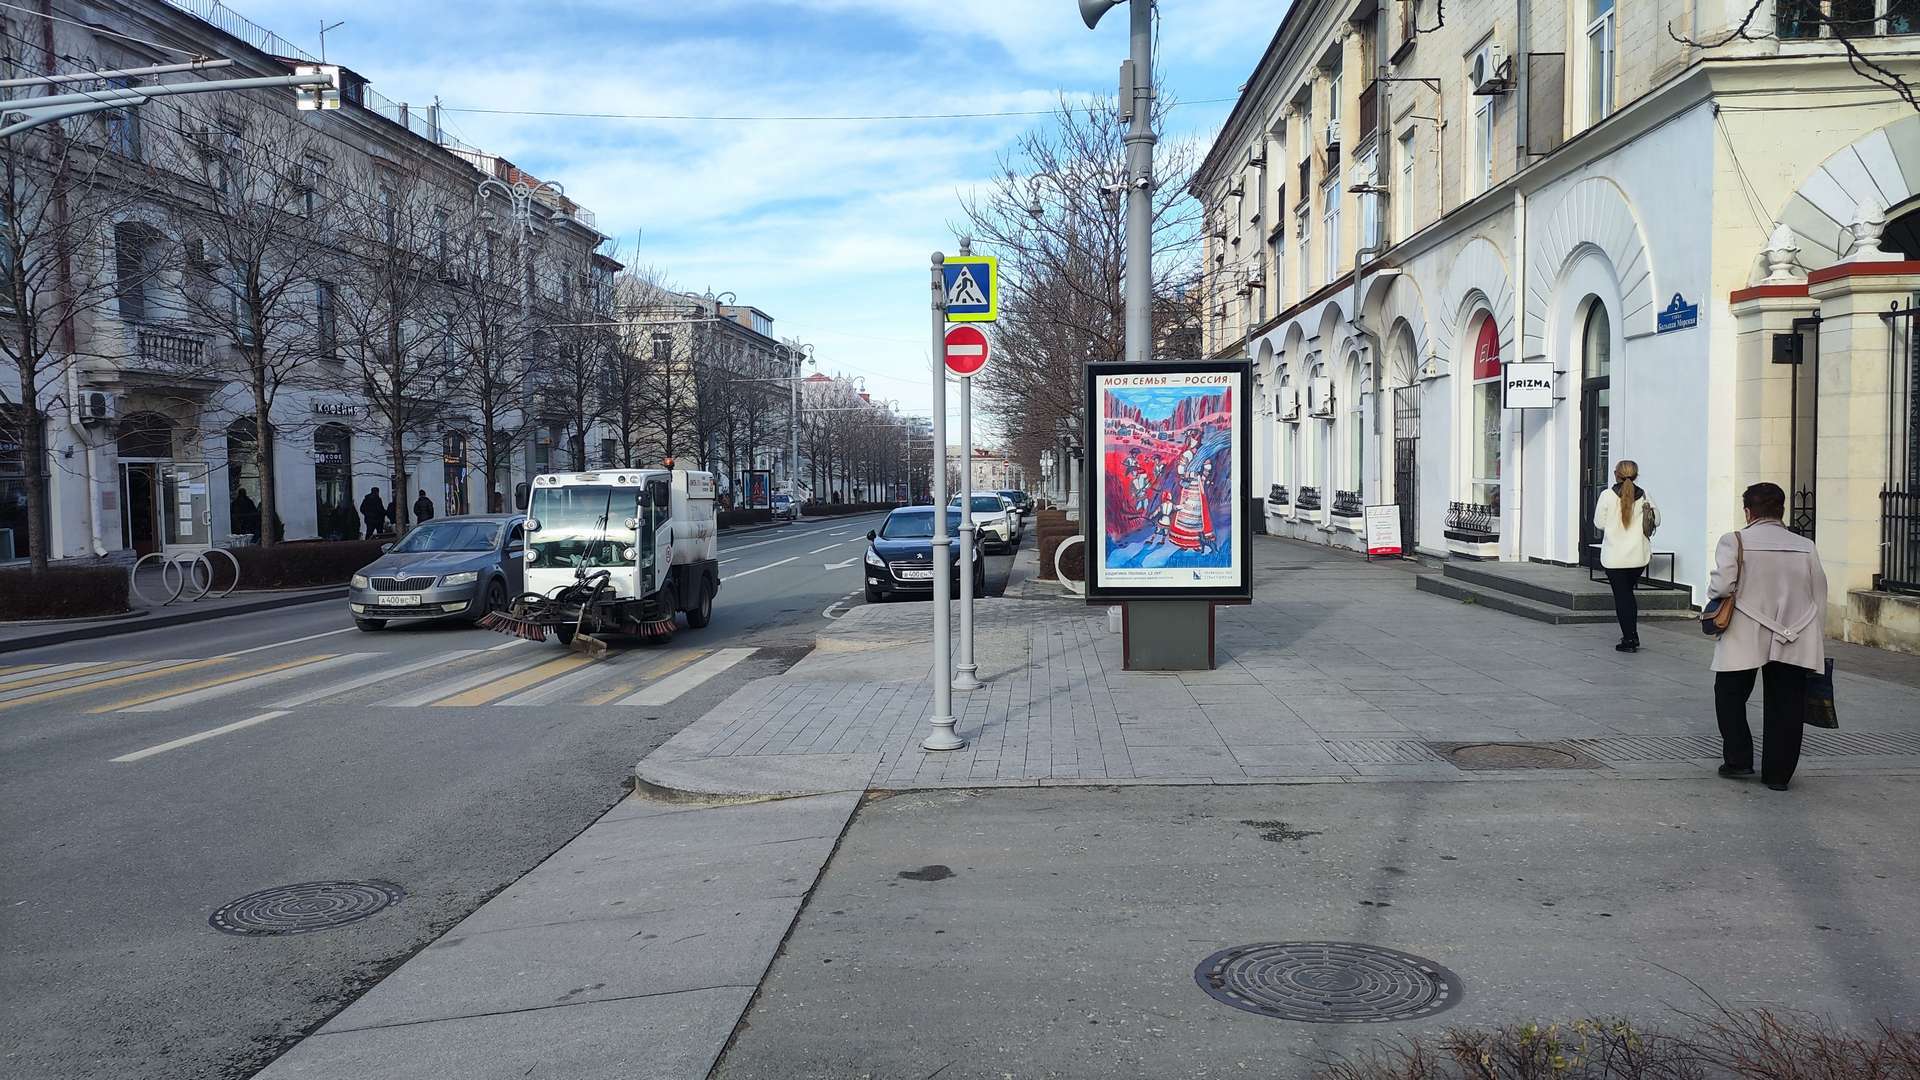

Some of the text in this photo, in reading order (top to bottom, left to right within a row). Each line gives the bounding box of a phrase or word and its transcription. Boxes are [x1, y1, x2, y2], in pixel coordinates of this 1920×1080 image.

[1674, 295, 1680, 310] 5
[1104, 377, 1129, 386] МОЯ
[1132, 376, 1167, 385] СЕМЬЯ
[1185, 375, 1228, 384] РОССИЯ
[1509, 379, 1551, 390] PRIZMA
